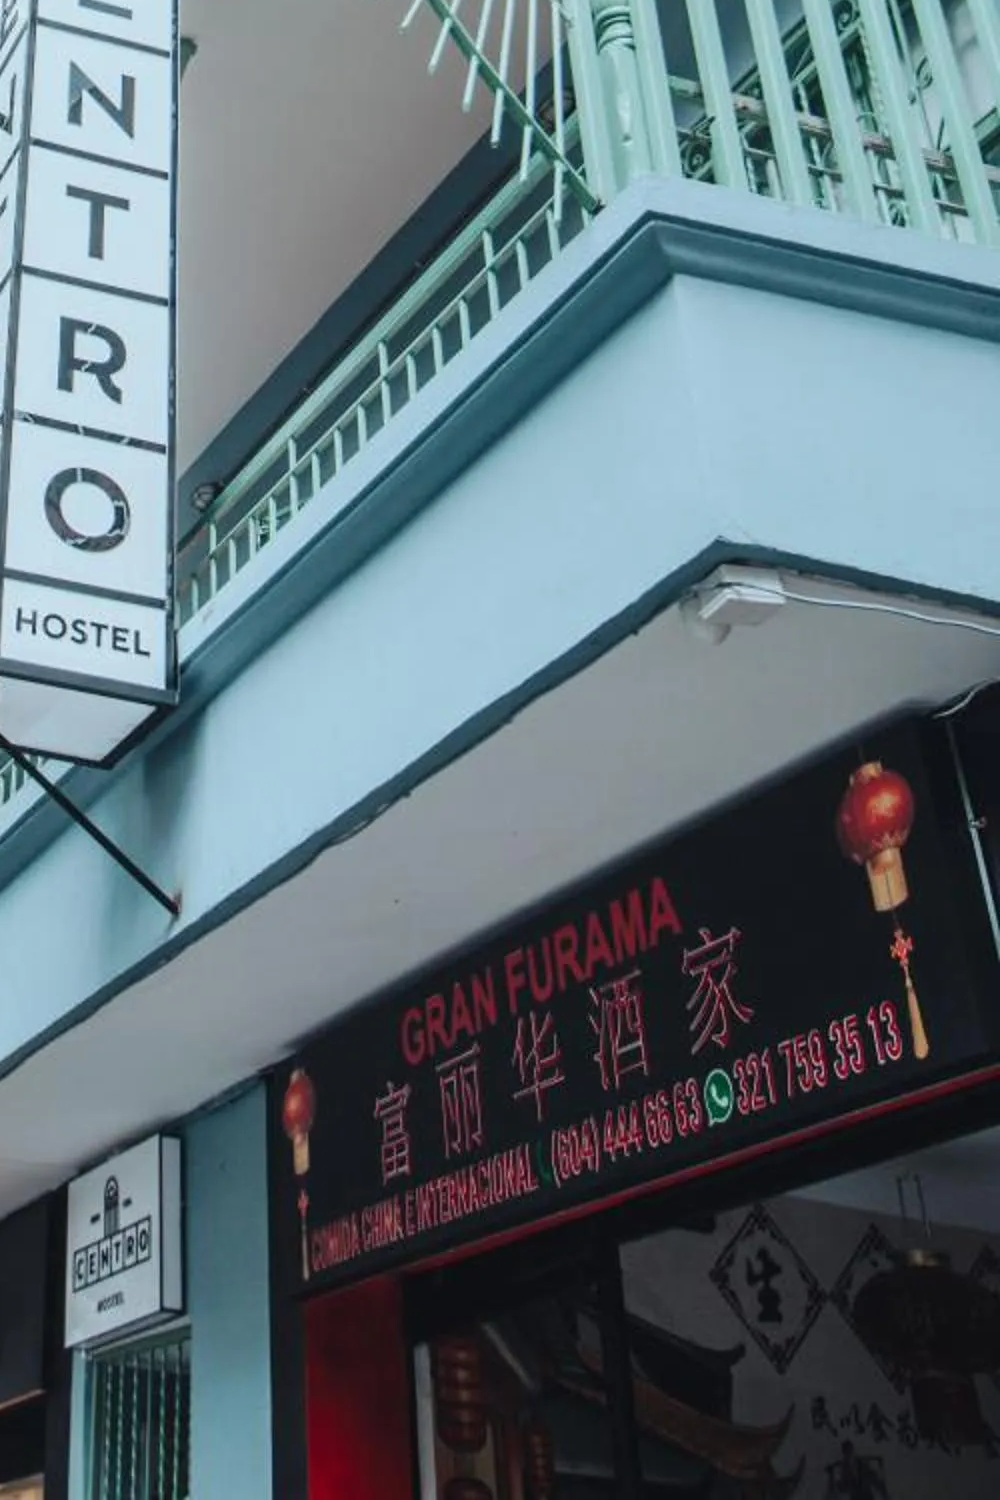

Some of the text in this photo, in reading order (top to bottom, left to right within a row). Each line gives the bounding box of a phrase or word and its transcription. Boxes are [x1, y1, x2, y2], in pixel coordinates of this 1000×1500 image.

[16, 608, 151, 658] HOSTEL
[400, 876, 683, 1067] GRAN FURAMA
[373, 926, 755, 1186] 富丽华酒家
[733, 1000, 904, 1116] 321 759 35 13
[551, 1077, 703, 1188] (604) 444 66 63
[76, 1229, 148, 1280] CENTRO
[311, 1142, 540, 1272] COMIDA CHINA E INTERNACIONAL
